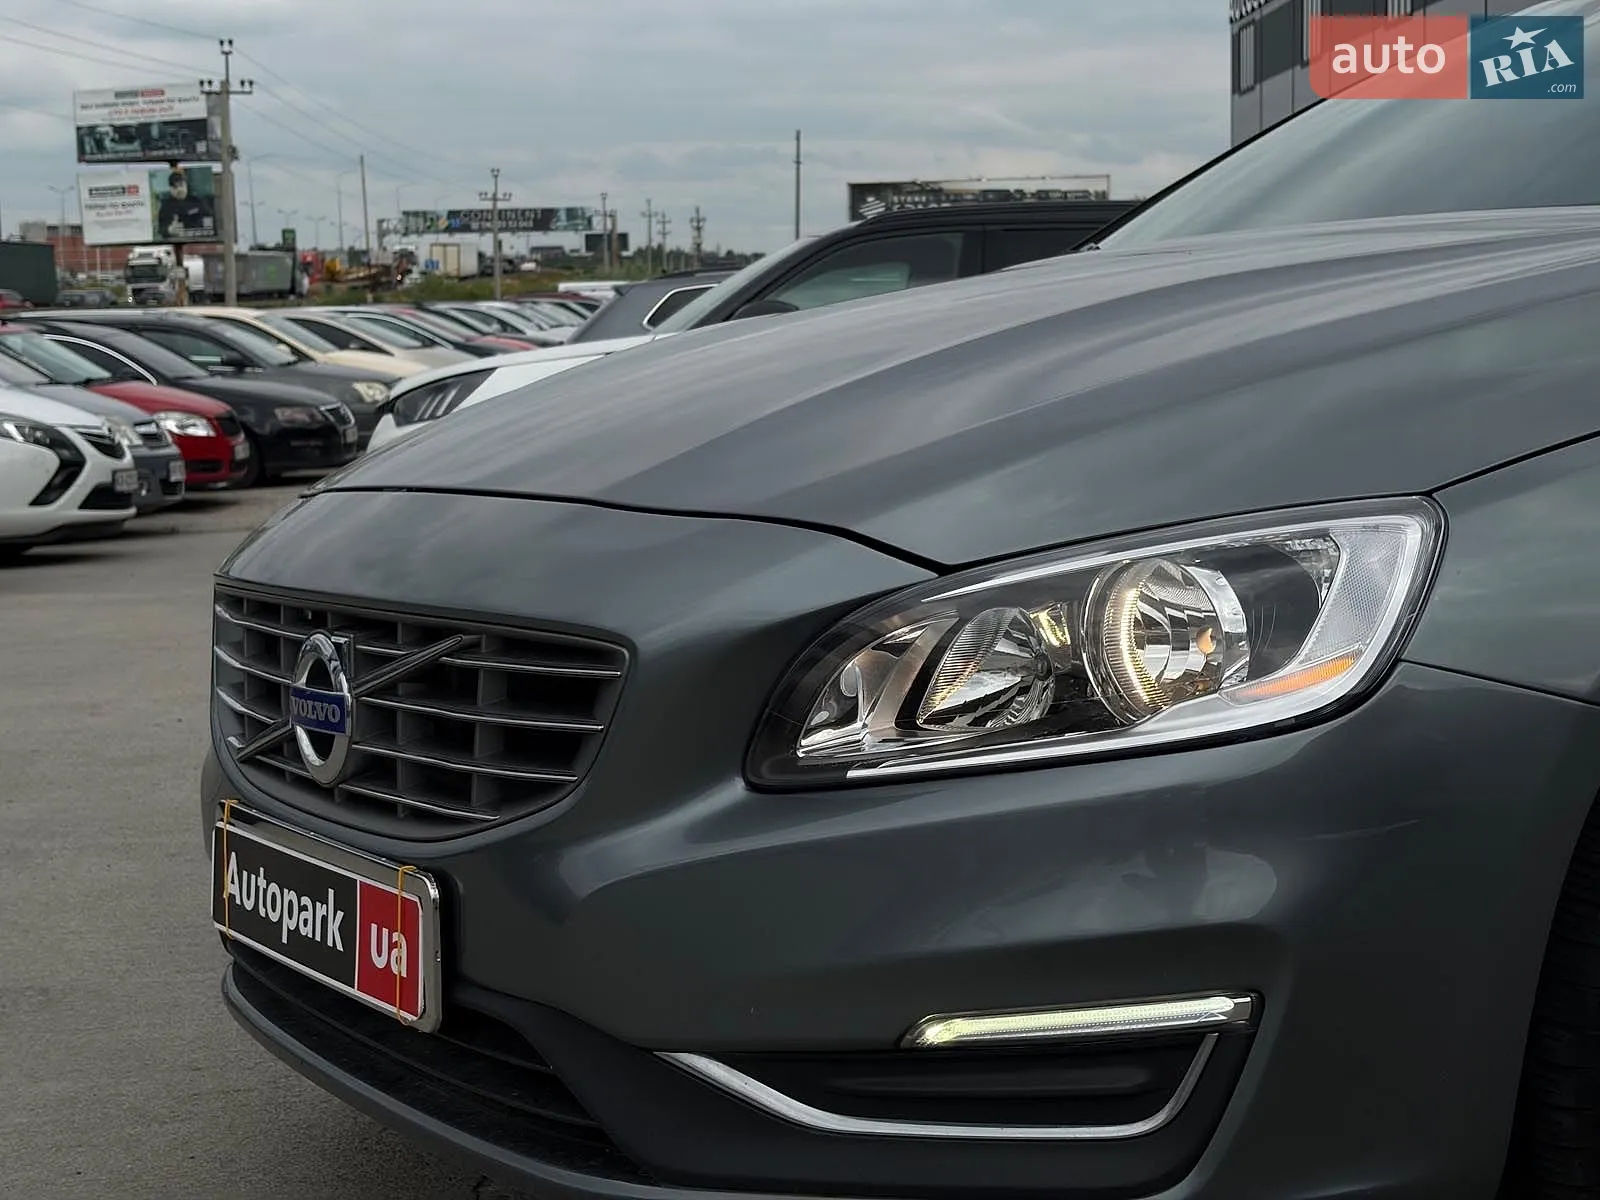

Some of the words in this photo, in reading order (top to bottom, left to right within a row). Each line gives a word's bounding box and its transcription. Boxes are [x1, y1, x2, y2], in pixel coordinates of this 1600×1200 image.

[291, 696, 340, 723] VOLVO
[225, 851, 345, 952] Autopark
[371, 923, 408, 978] ua
